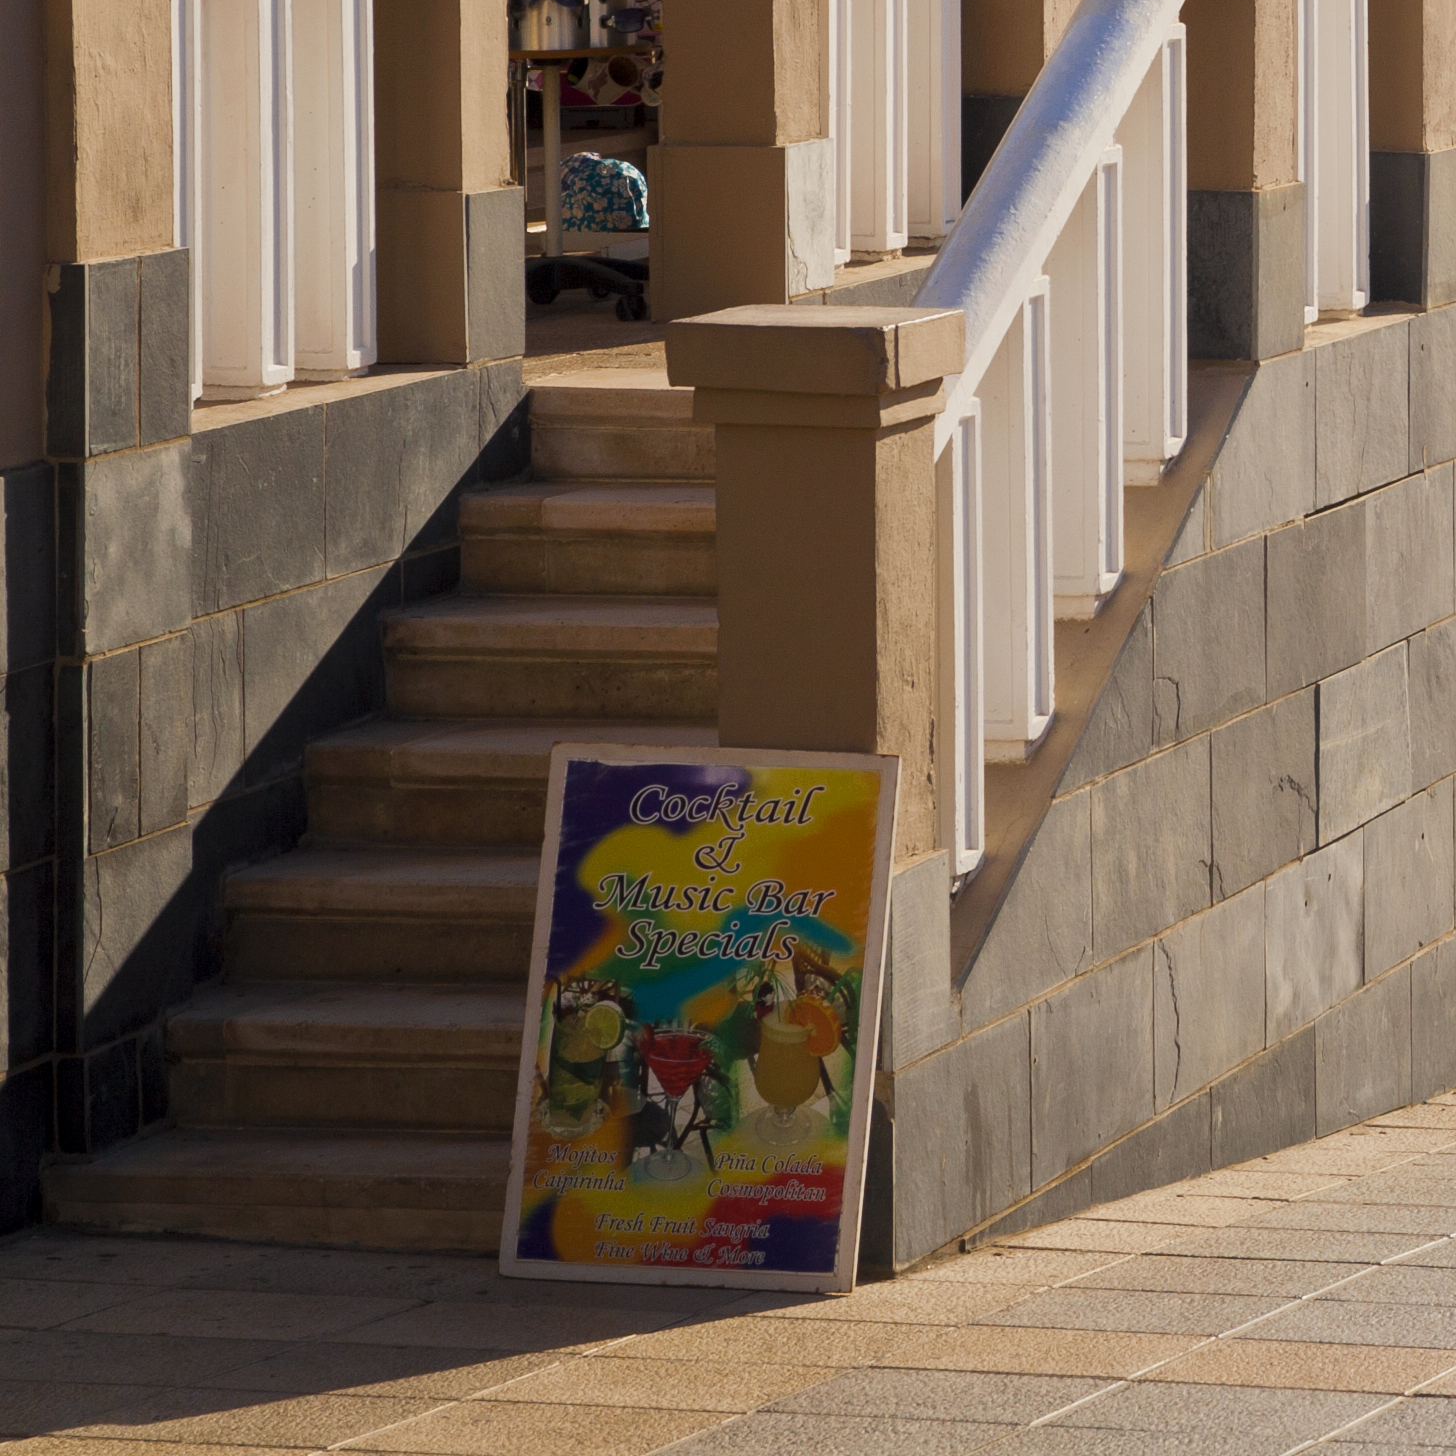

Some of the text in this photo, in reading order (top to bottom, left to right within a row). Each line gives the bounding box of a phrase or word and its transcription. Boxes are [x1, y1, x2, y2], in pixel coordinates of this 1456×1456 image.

[628, 783, 826, 831] Cocktail
[692, 830, 747, 875] &
[592, 870, 837, 918] Music Bar
[614, 917, 801, 970] Specials
[546, 1143, 618, 1170] Mojitos
[713, 1151, 824, 1176] Piña Colada
[532, 1169, 627, 1195] Caipirinha
[706, 1177, 828, 1206] Cosmopolitan
[593, 1212, 771, 1244] Fresh Fruit Sangria
[593, 1240, 766, 1266] Fine Wine & More
